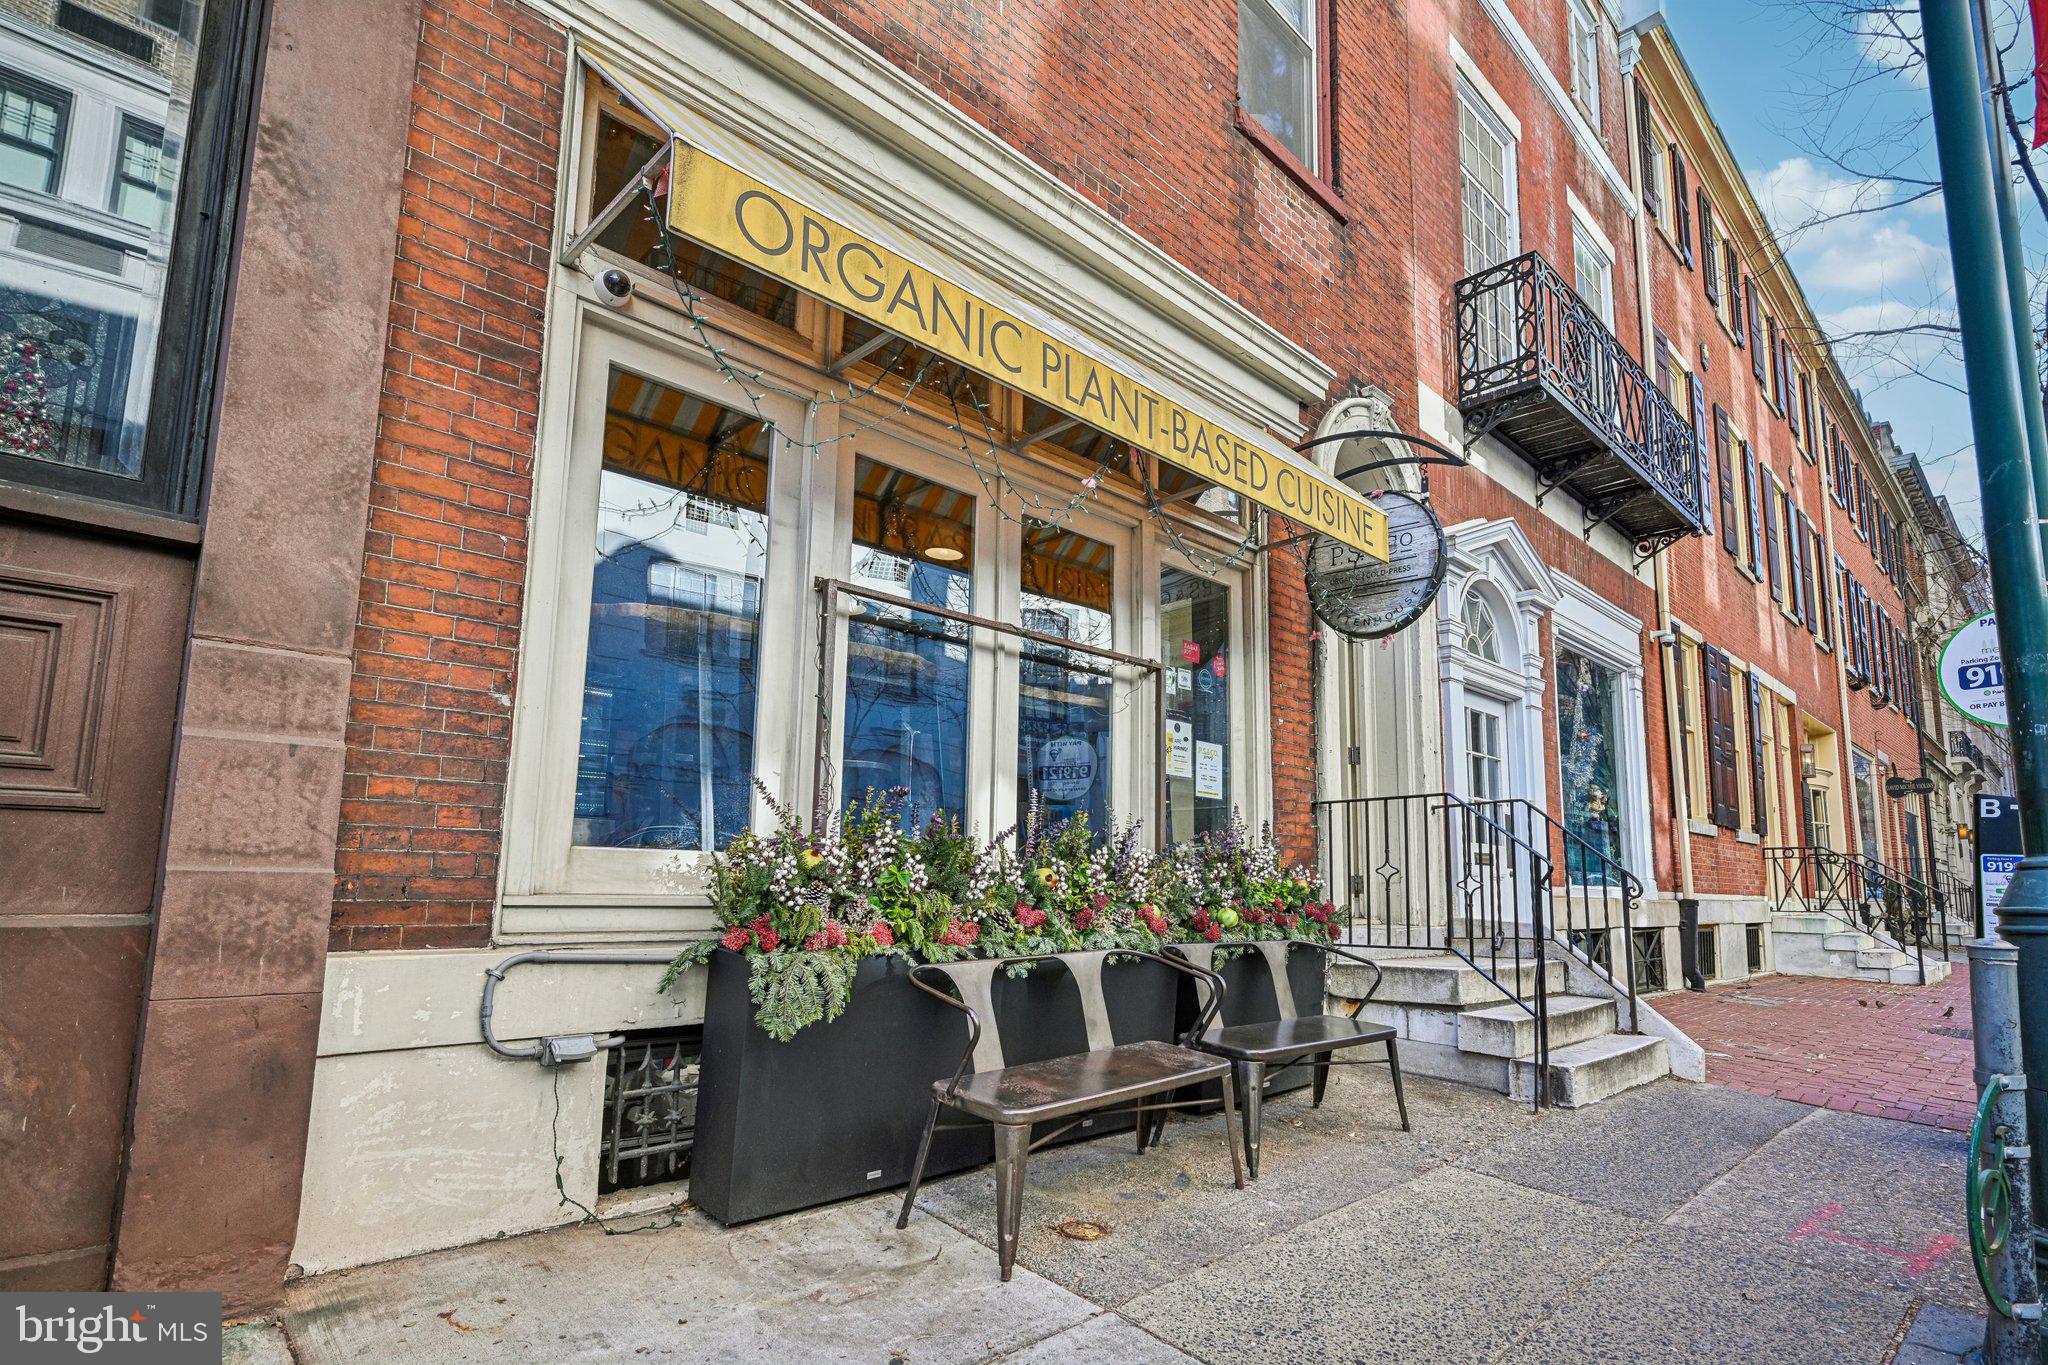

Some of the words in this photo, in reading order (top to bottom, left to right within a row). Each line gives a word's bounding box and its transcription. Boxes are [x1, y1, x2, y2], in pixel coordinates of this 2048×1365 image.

[735, 190, 1022, 373] ORGANIC
[1042, 341, 1268, 492] PLANT-BASED
[1276, 469, 1374, 547] CUISINE
[1961, 656, 1988, 665] Parking
[1966, 665, 2003, 688] 91
[1986, 861, 2017, 872] 919
